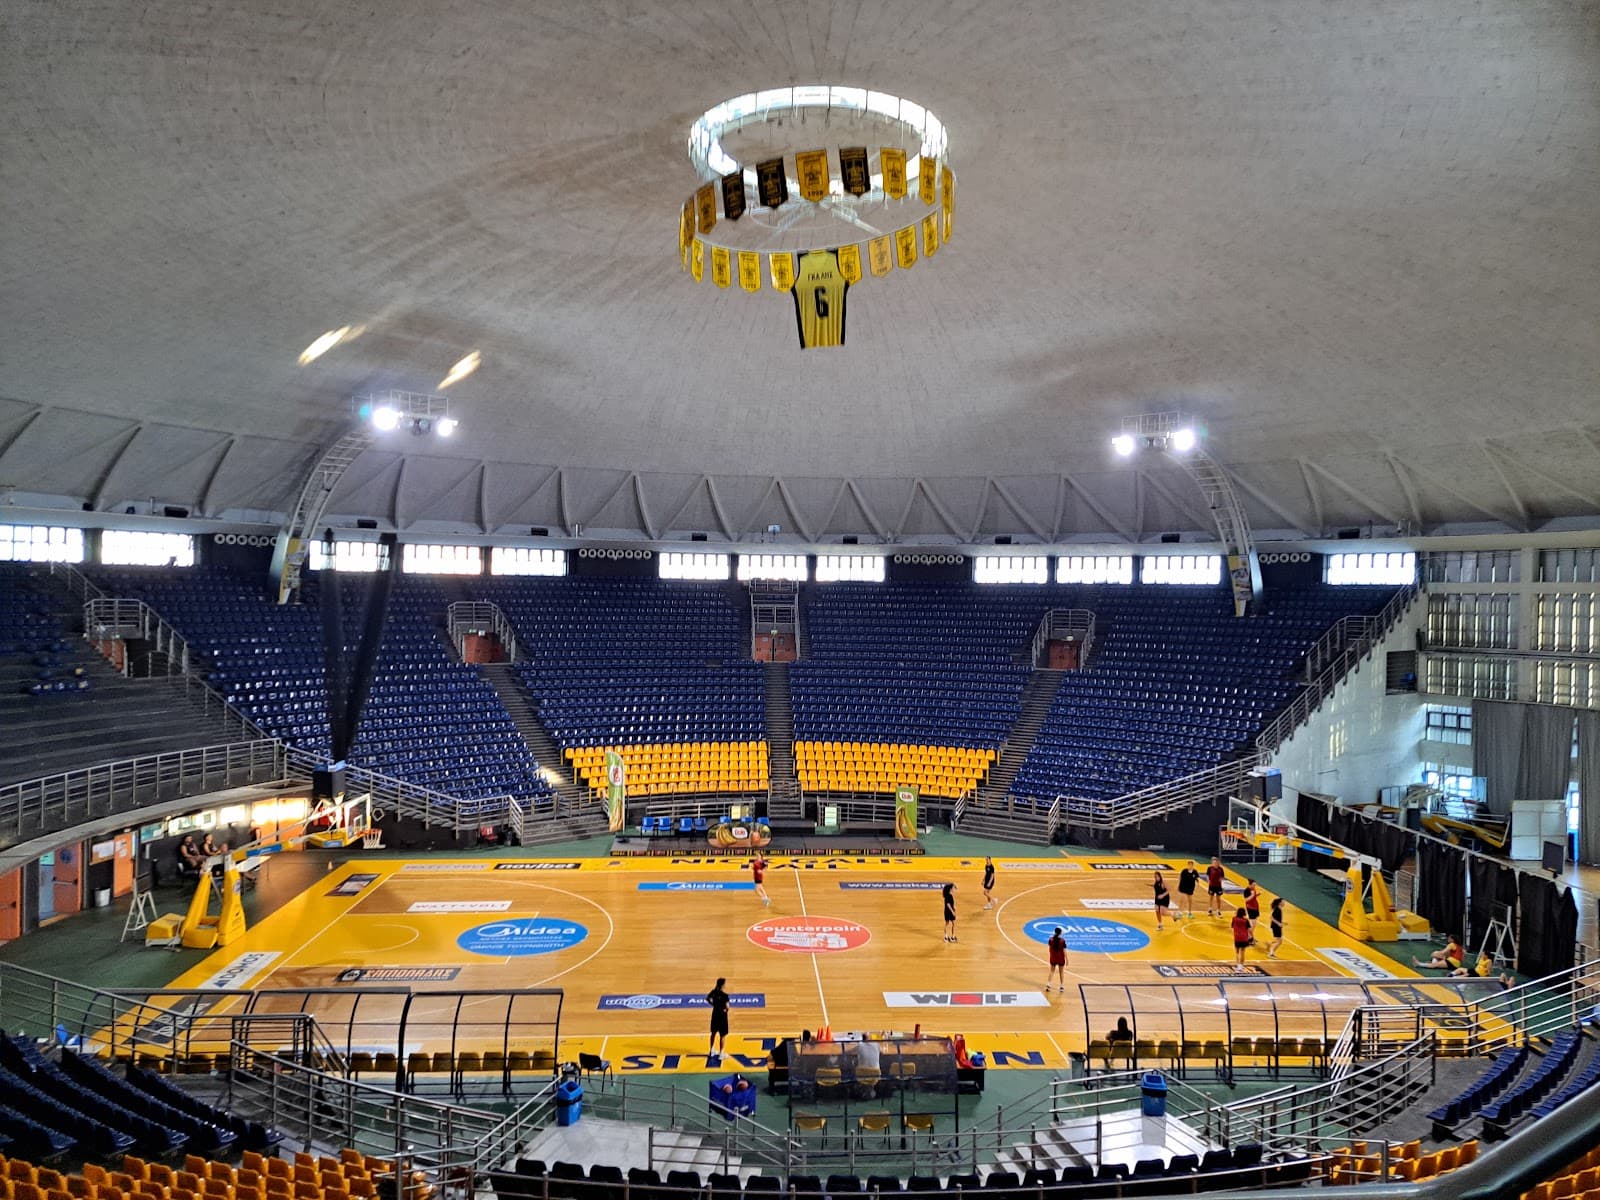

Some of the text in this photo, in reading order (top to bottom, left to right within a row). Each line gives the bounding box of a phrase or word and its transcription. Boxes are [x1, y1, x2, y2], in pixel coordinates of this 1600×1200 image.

[814, 286, 829, 318] 6
[482, 924, 577, 936] Midea
[1040, 922, 1130, 934] Midea
[910, 993, 1017, 1005] WOLF
